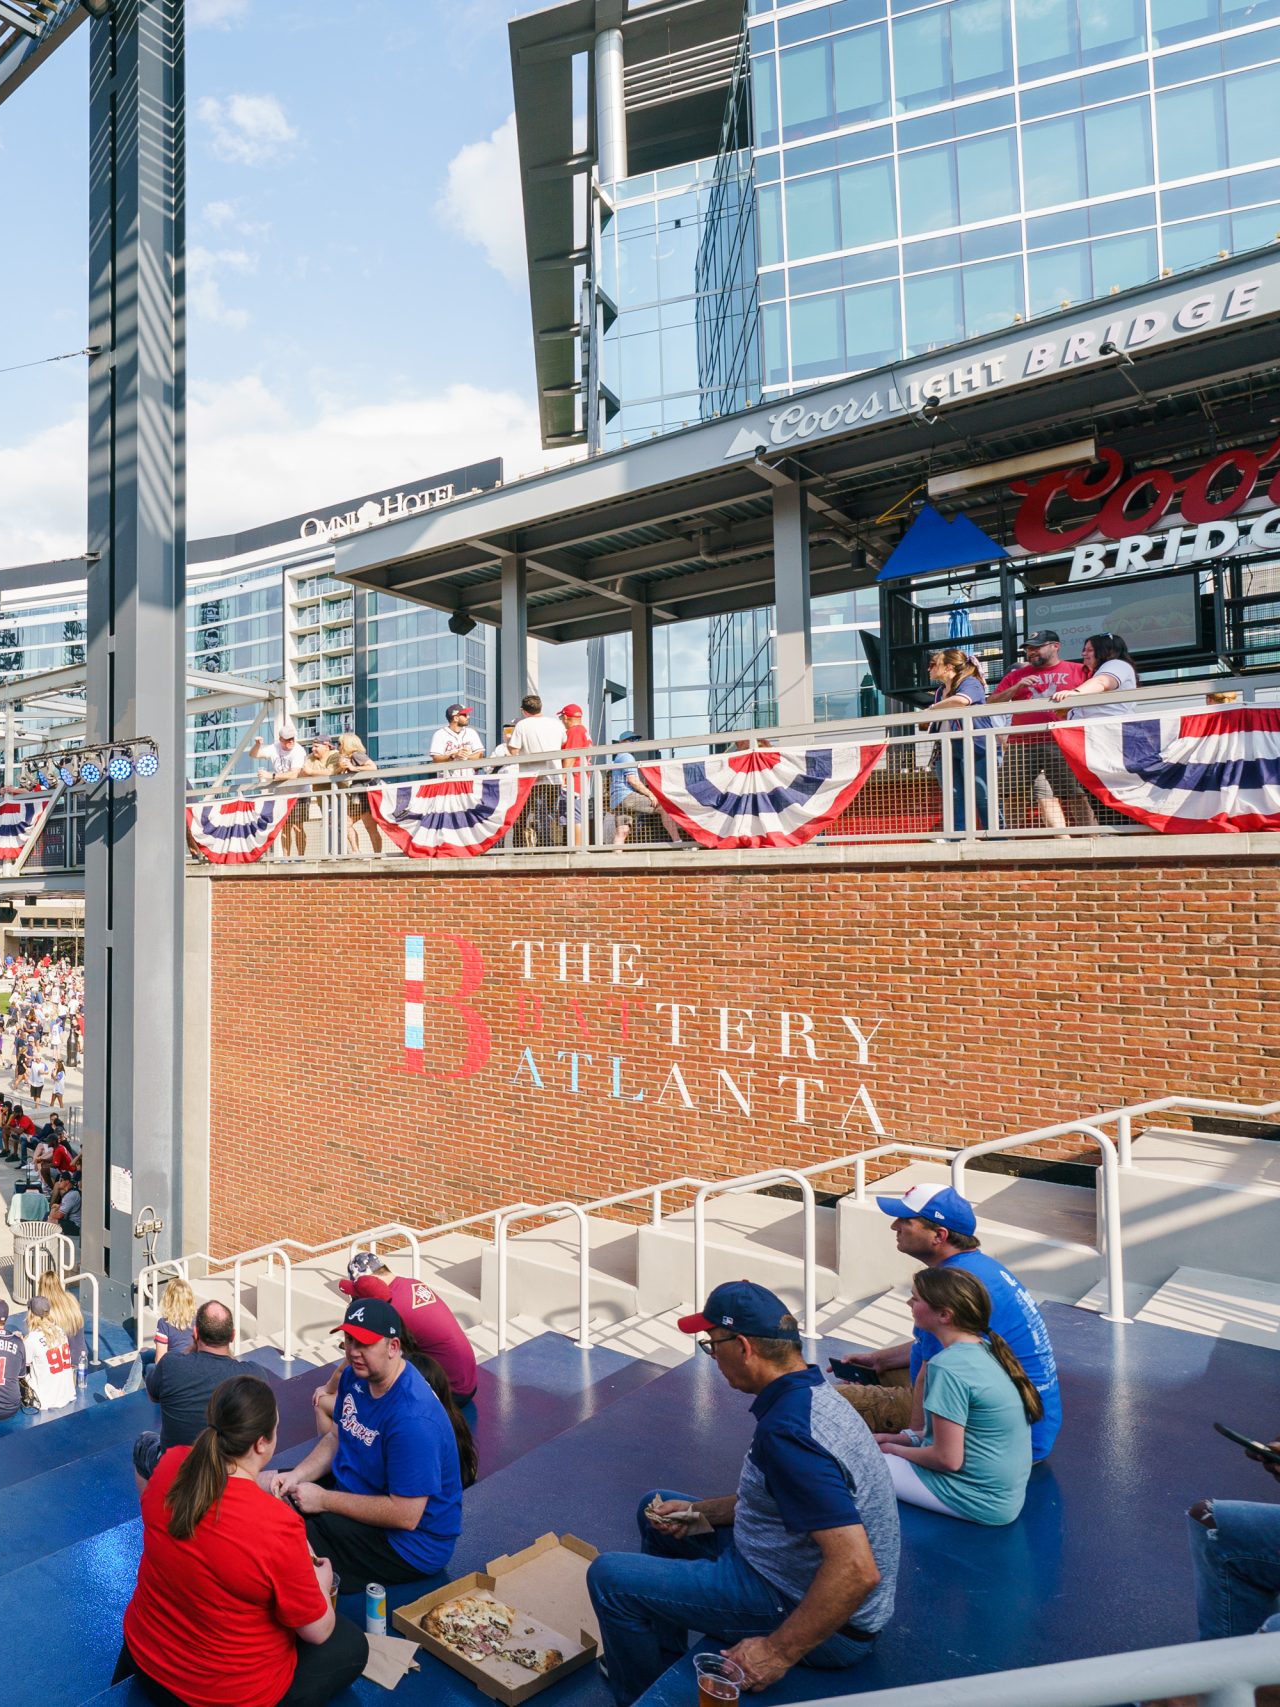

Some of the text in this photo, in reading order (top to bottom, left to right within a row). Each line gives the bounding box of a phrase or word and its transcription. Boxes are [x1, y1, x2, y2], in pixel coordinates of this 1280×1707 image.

[769, 278, 1263, 446] Coors LIGHT BRIDGE
[300, 484, 455, 539] OMNI HOTEL
[1009, 434, 1280, 553] Coo
[511, 940, 644, 986] THE
[389, 931, 492, 1081] B
[517, 994, 891, 1065] BATTERY
[509, 1046, 895, 1136] ATLANTA
[348, 1306, 366, 1322] A
[46, 1343, 72, 1375] 99
